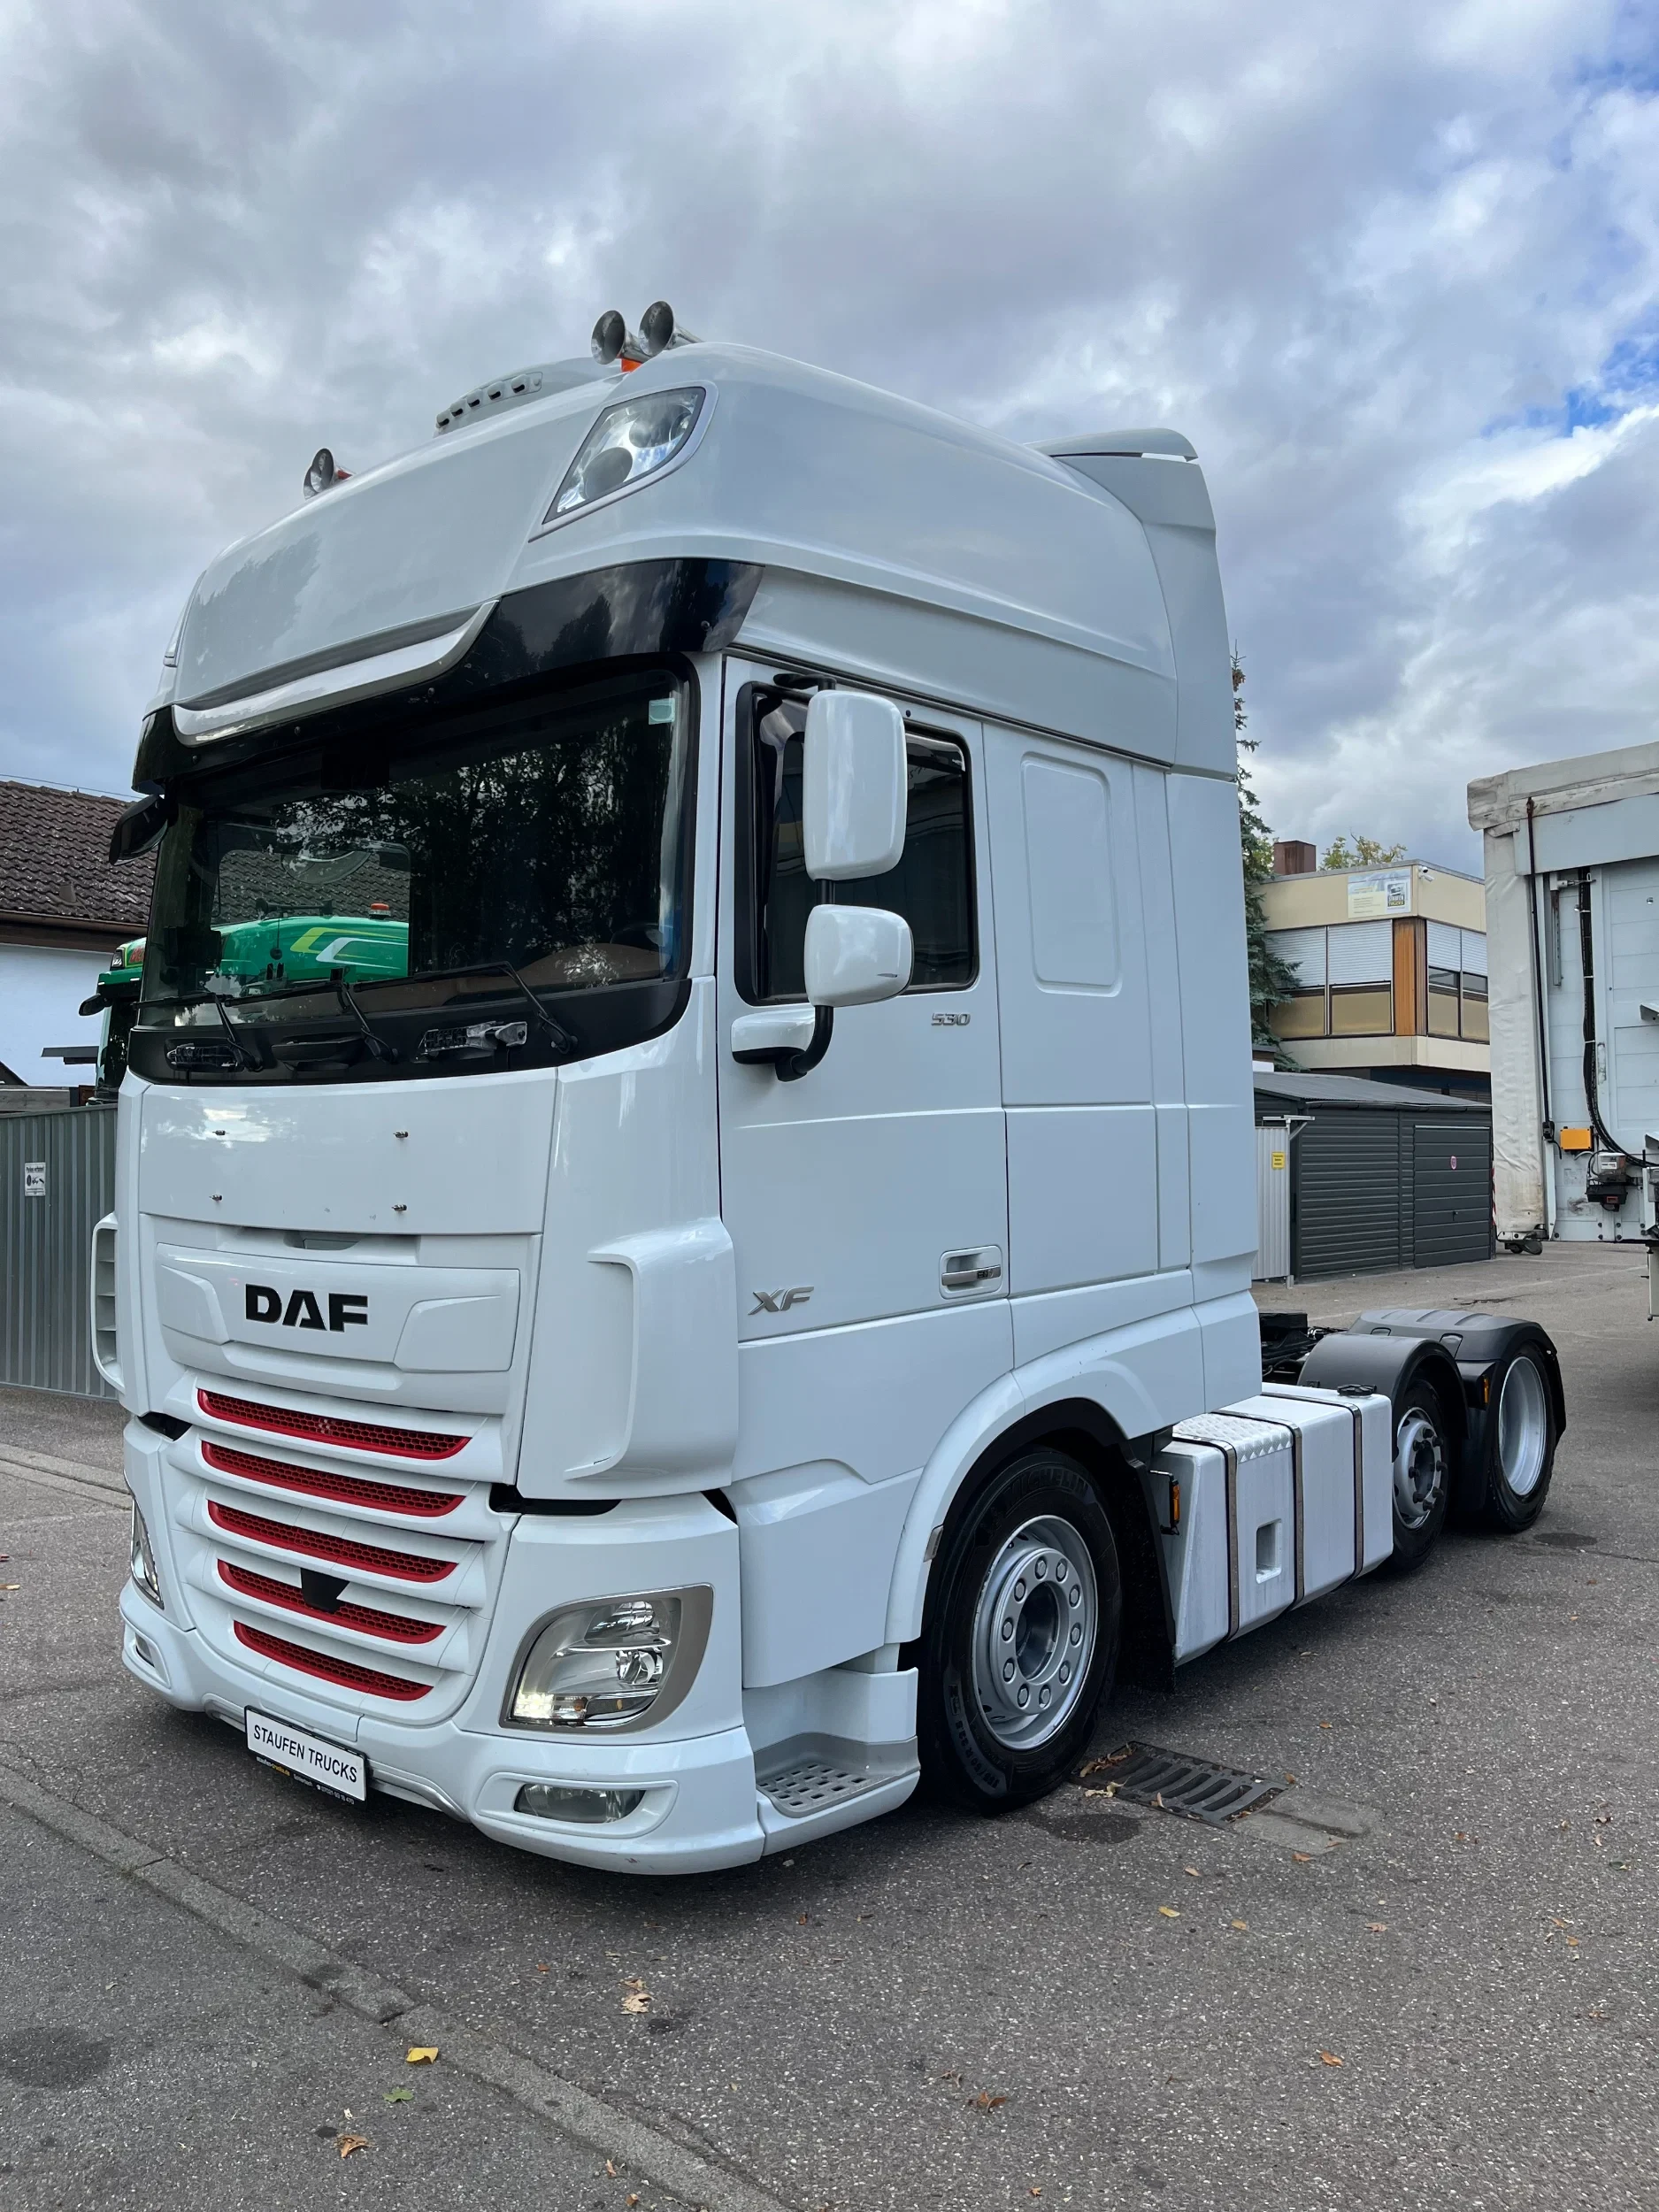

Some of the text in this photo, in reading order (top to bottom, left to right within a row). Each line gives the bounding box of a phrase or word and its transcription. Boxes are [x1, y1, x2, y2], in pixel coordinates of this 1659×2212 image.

[931, 1012, 972, 1026] 530
[245, 1283, 368, 1333] DAF
[747, 1286, 815, 1316] XF
[1002, 1466, 1087, 1509] MICHELIN
[254, 1724, 357, 1783] STAUFEN TRUCKS
